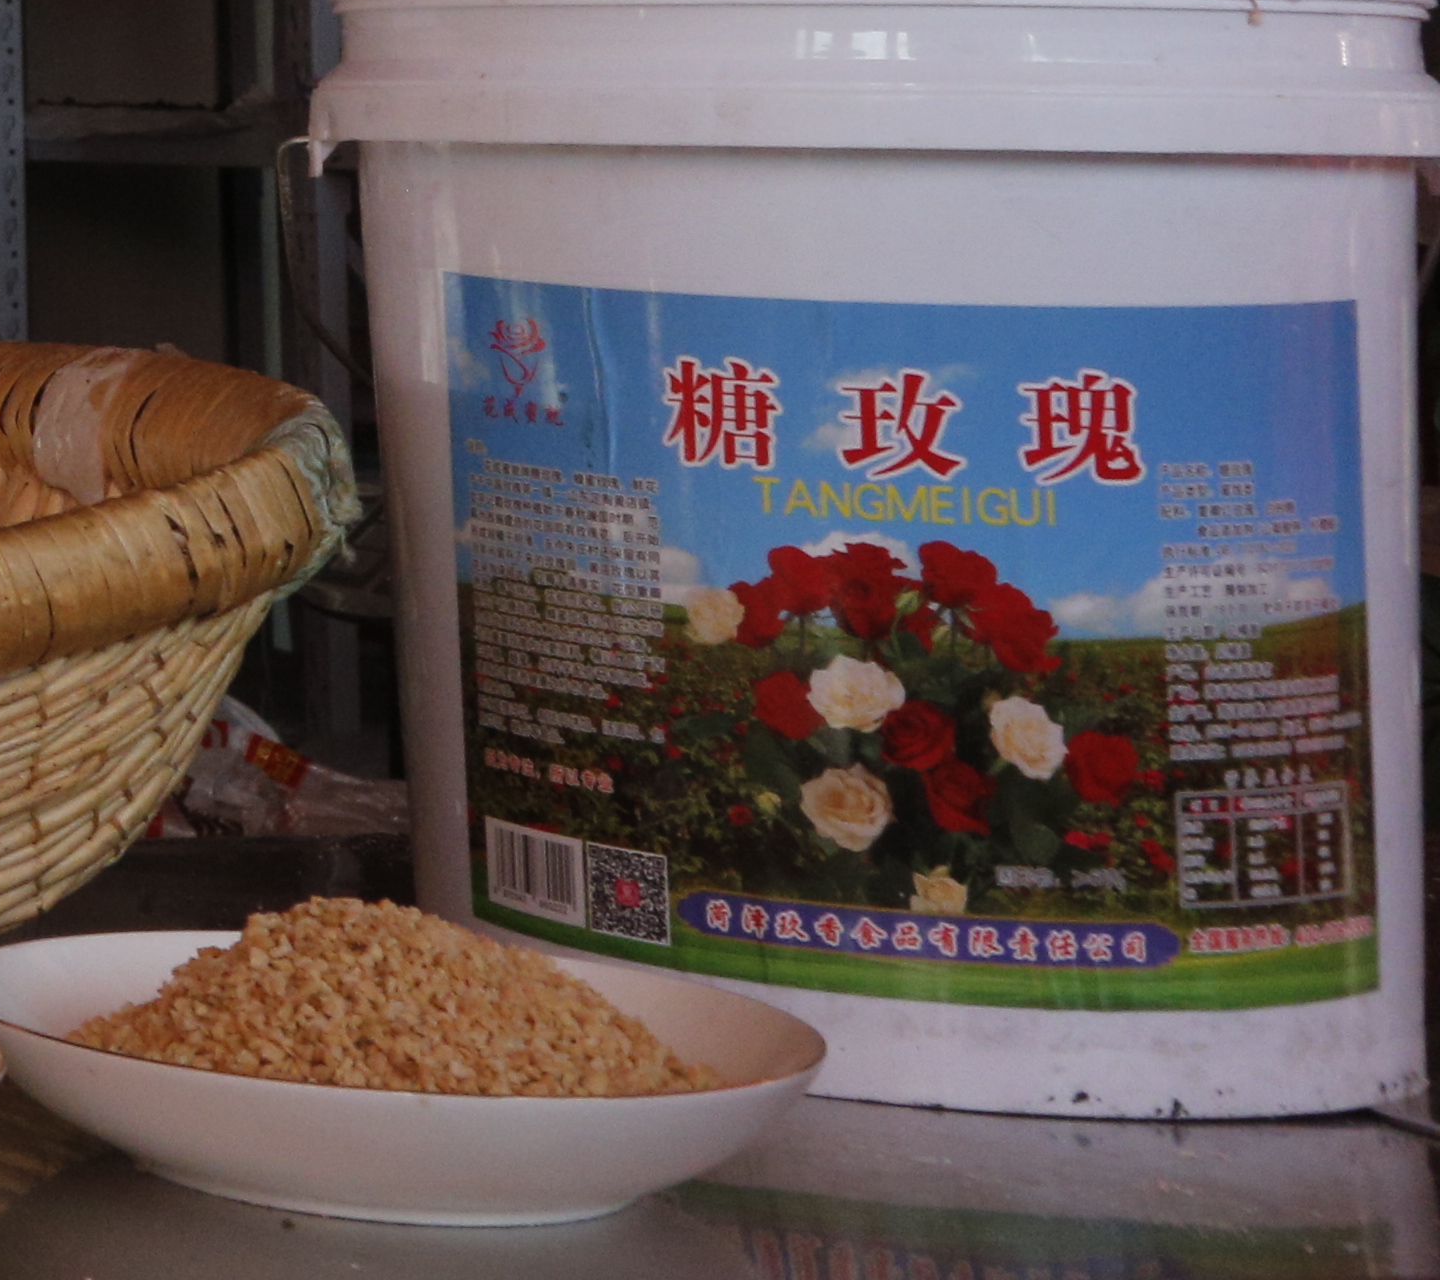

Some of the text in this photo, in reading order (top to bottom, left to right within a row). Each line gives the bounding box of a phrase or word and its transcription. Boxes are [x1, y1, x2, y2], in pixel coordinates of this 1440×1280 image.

[662, 357, 1146, 486] 糖玫瑰
[753, 474, 1058, 528] TANGMEIGUI
[705, 898, 1148, 963] 菏泽玖香食品有限责任公司
